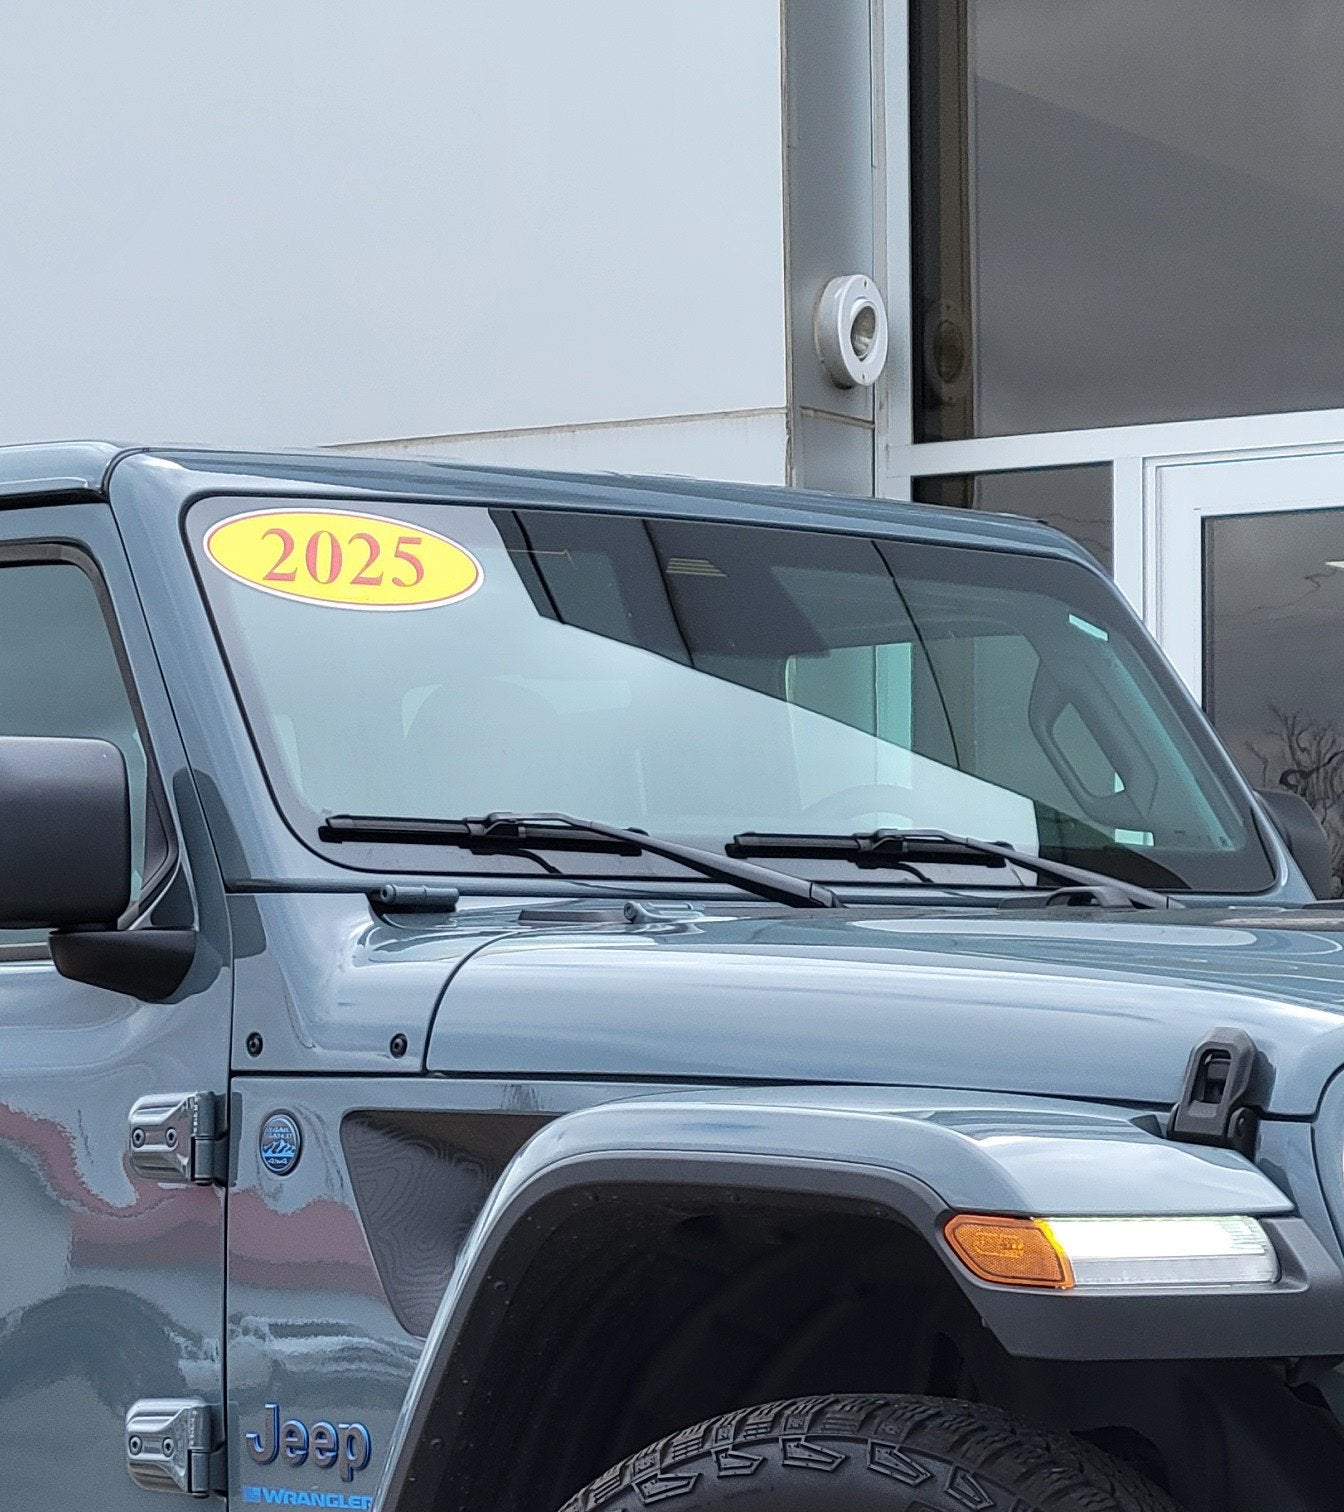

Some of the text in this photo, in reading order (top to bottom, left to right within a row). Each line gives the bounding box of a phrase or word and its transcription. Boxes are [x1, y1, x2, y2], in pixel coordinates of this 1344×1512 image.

[261, 528, 424, 588] 2025
[245, 1403, 372, 1483] Jeep
[262, 1487, 373, 1511] WRANGLER
